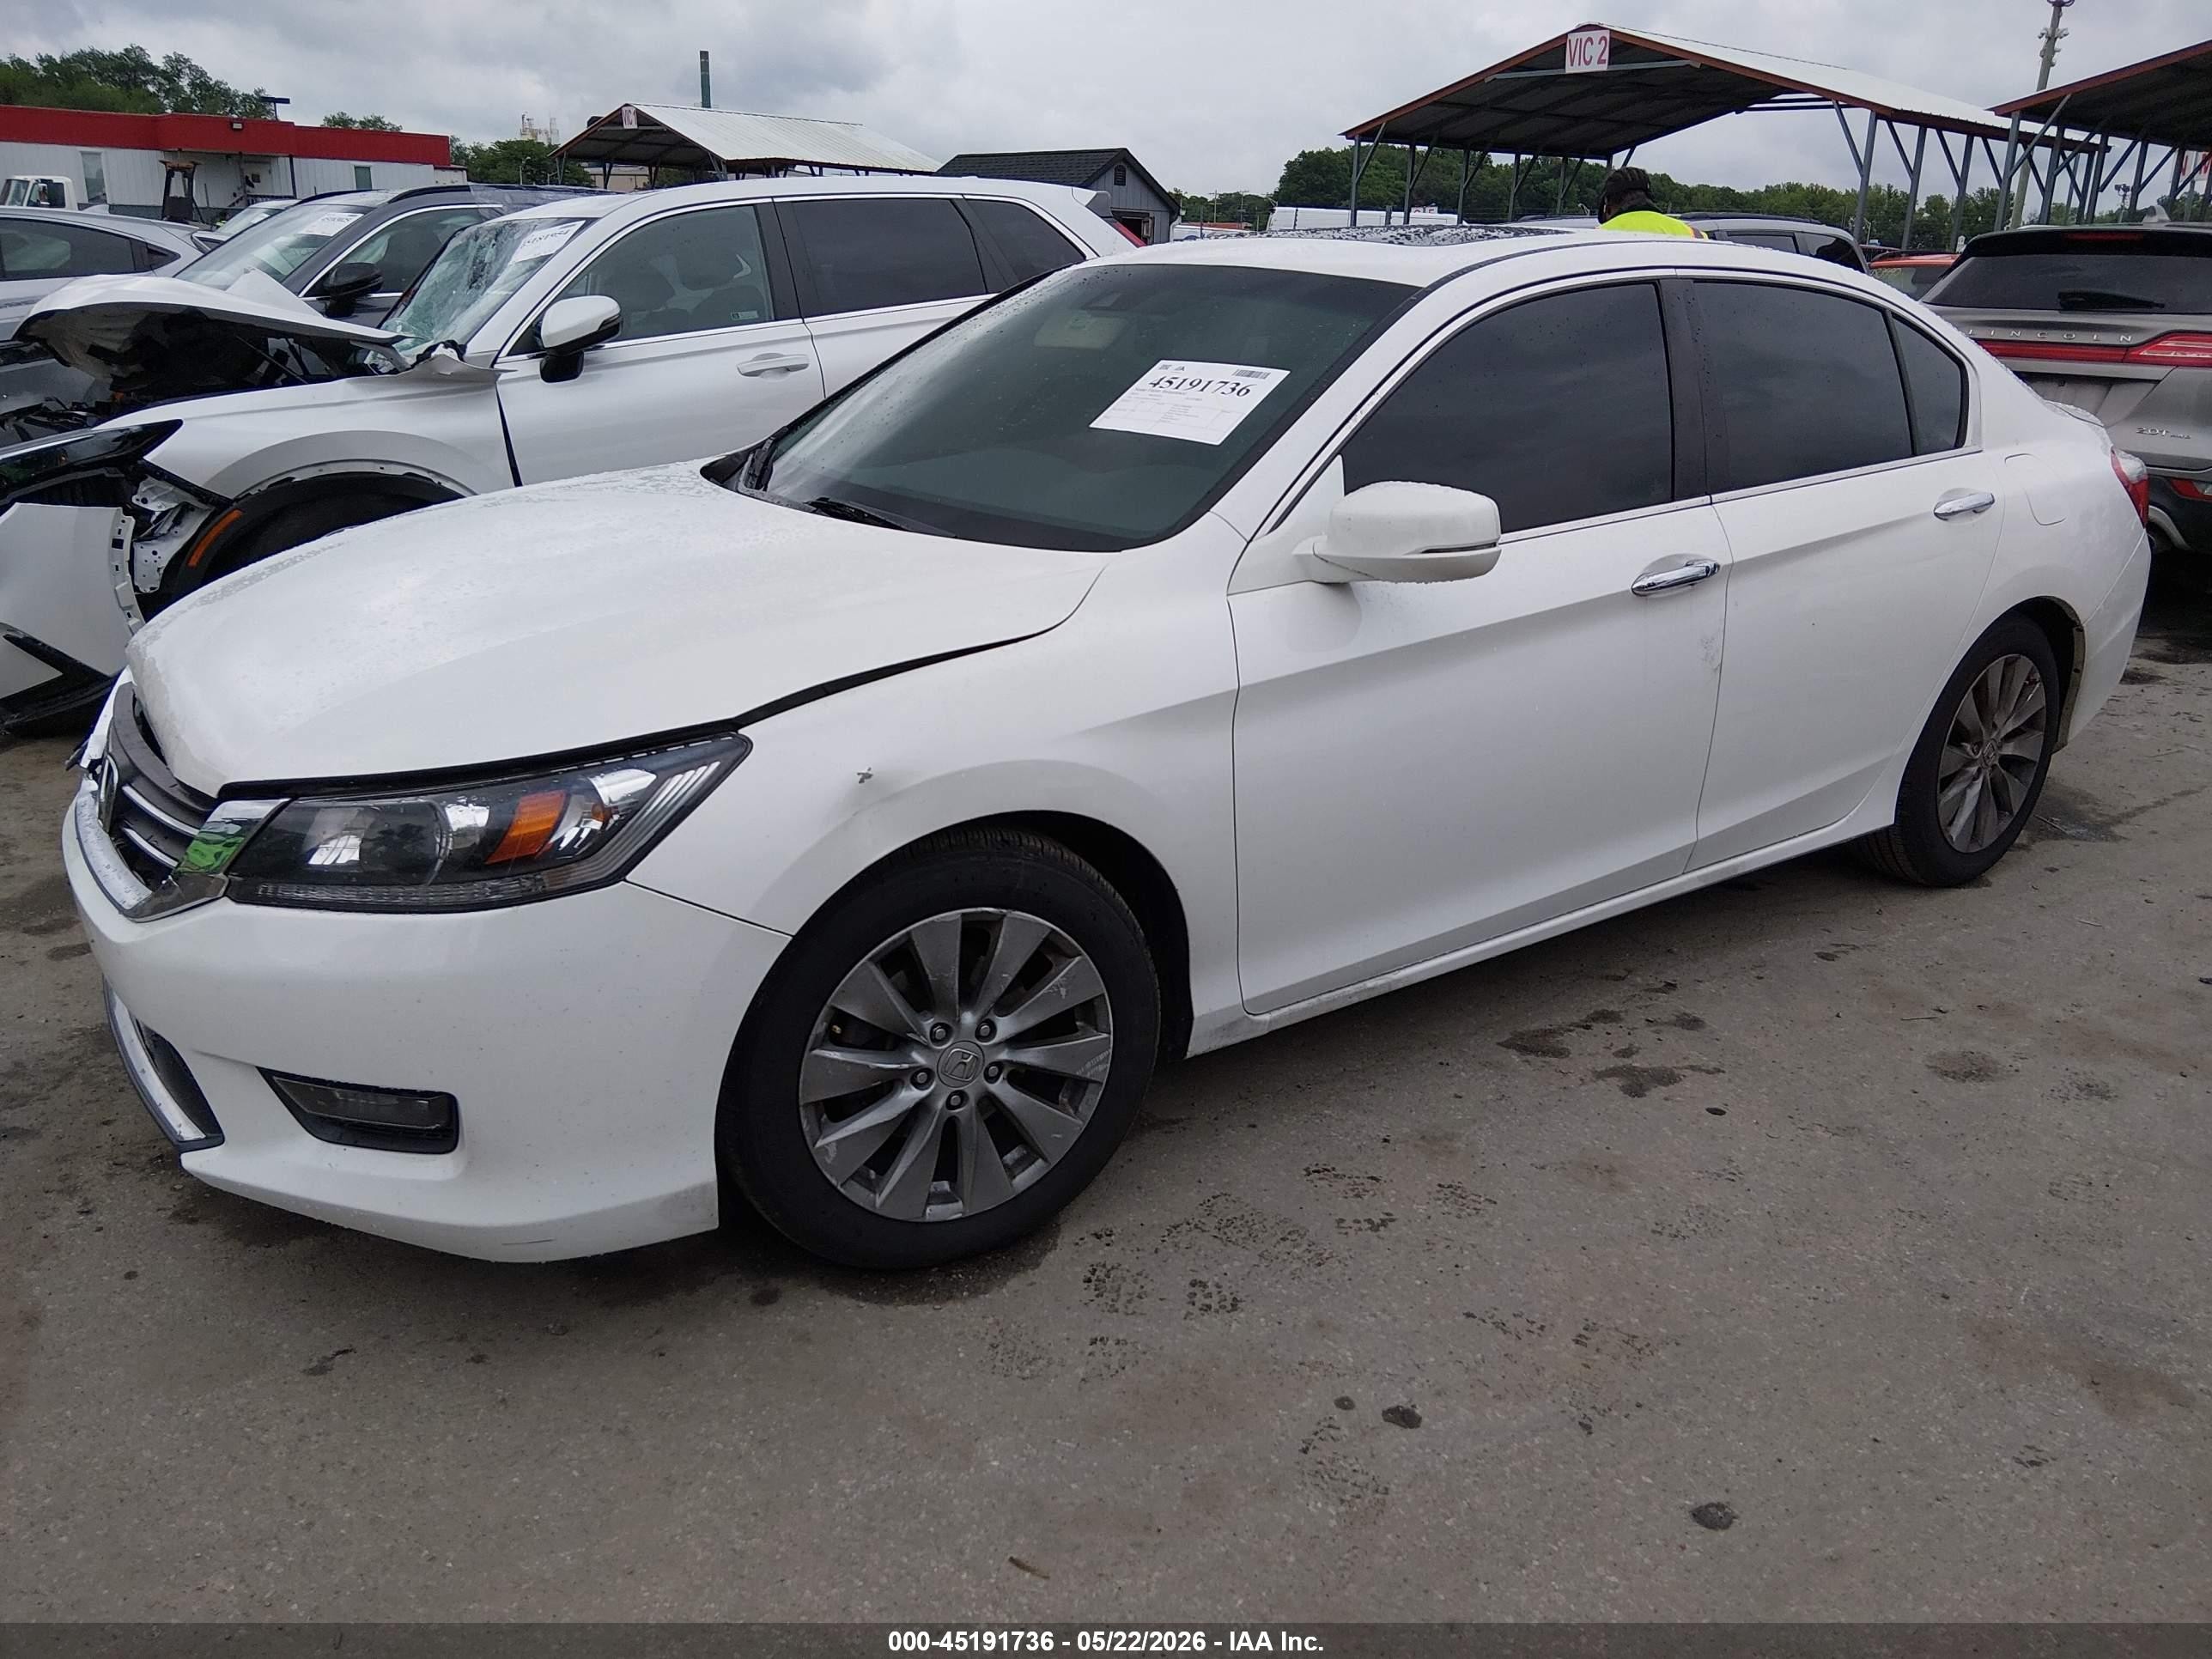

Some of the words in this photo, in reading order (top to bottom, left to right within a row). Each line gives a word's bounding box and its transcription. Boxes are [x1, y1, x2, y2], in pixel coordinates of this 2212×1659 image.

[1568, 36, 1594, 67] VIC
[1597, 35, 1608, 64] 2
[622, 109, 634, 125] VIC
[1968, 328, 2131, 343] LINCOLN
[1148, 375, 1258, 398] 45191736
